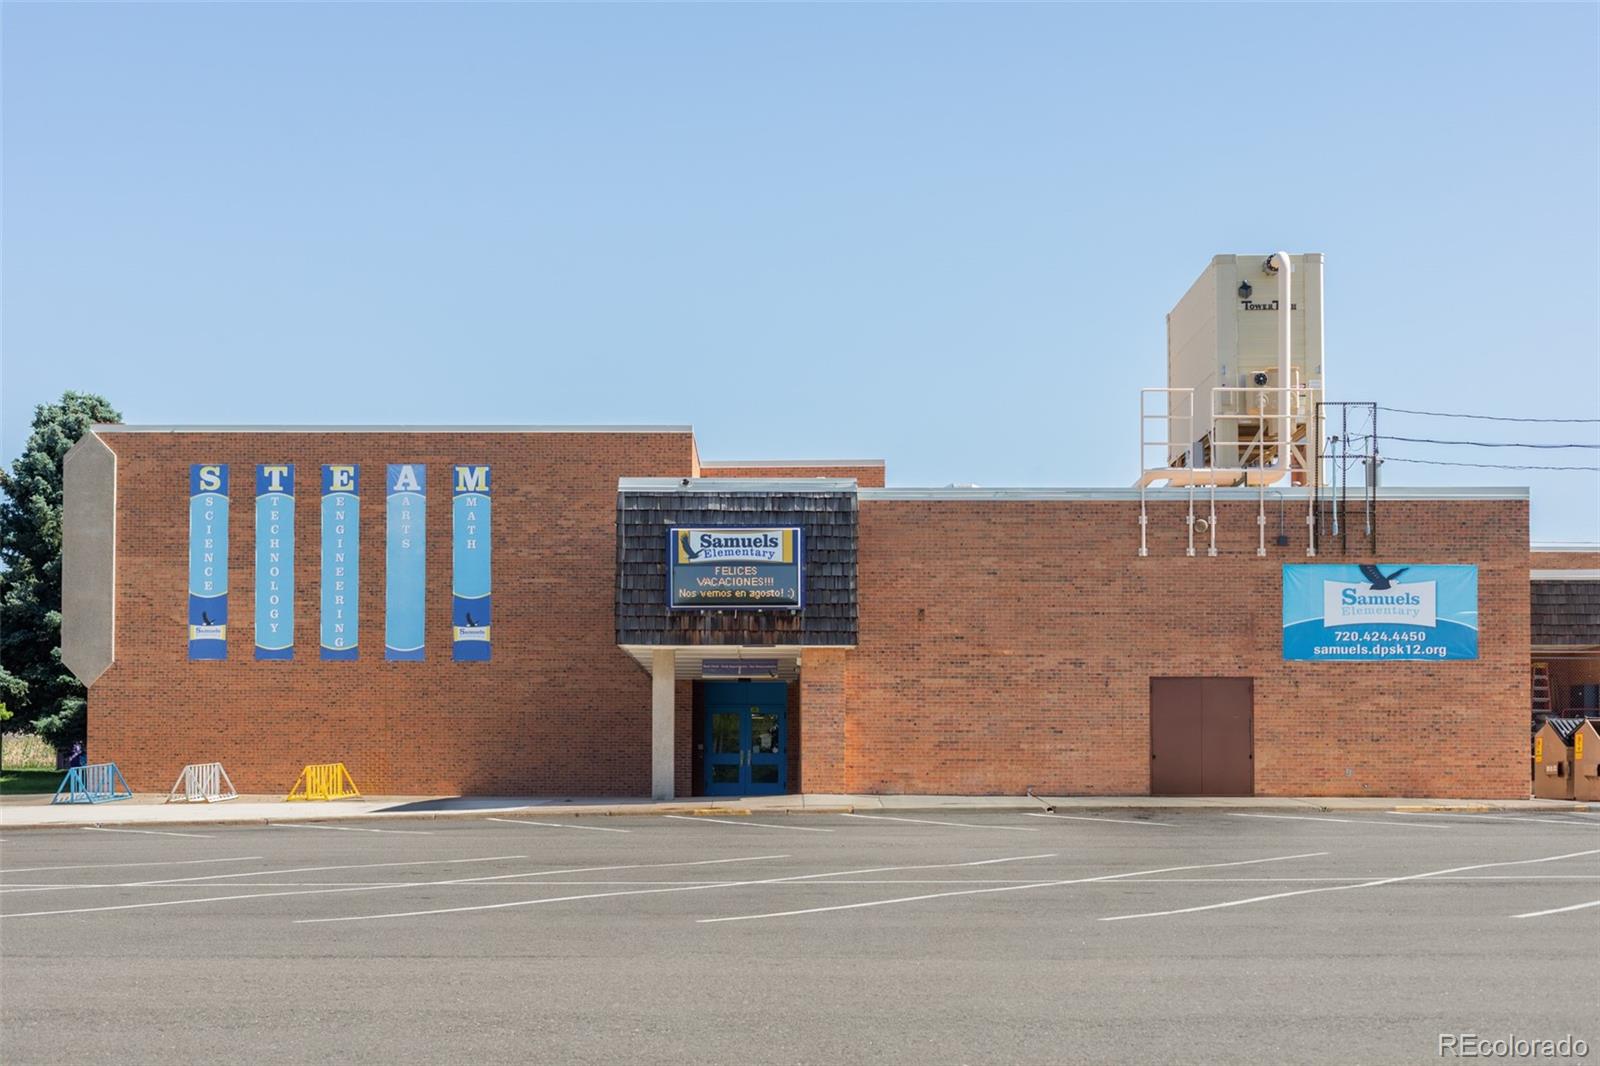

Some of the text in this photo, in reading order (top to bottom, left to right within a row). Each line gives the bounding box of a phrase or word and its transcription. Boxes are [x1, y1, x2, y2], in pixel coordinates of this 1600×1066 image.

[199, 465, 489, 491] S T E A M
[401, 496, 411, 549] ARTS
[465, 497, 478, 549] MATH
[204, 496, 214, 591] SCIENCE
[700, 533, 779, 549] Samuels
[704, 548, 775, 560] Elementary
[269, 496, 280, 633] TECHNOLOGY
[335, 496, 345, 648] ENGINEERING
[714, 566, 758, 576] FELICES
[696, 577, 774, 587] VACACIONES!!!
[679, 588, 697, 598] Nos
[700, 590, 731, 598] vemos
[735, 590, 746, 598] en
[749, 588, 784, 600] agosto!
[1341, 588, 1420, 606] Samuels
[1341, 606, 1420, 618] Elementary
[1334, 631, 1426, 642] 720.424.4450
[1313, 644, 1447, 657] samuels.dpsk12.org
